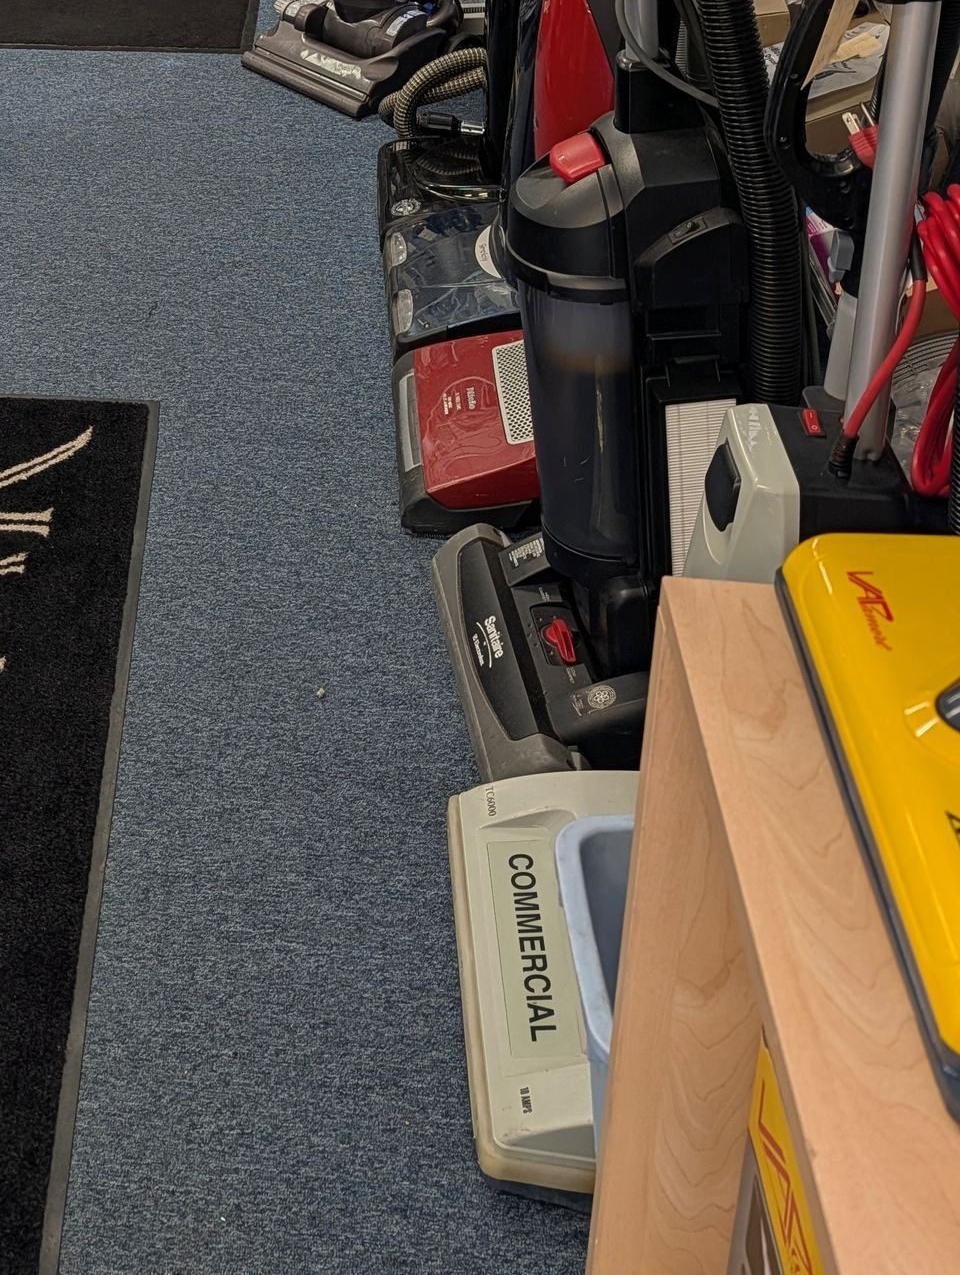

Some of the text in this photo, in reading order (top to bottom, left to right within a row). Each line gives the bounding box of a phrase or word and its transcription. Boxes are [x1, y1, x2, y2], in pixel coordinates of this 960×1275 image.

[484, 614, 504, 660] Sanitaire
[485, 786, 497, 817] TC6000
[507, 852, 558, 1043] COMMERCIAL
[521, 1095, 533, 1115] AMPS
